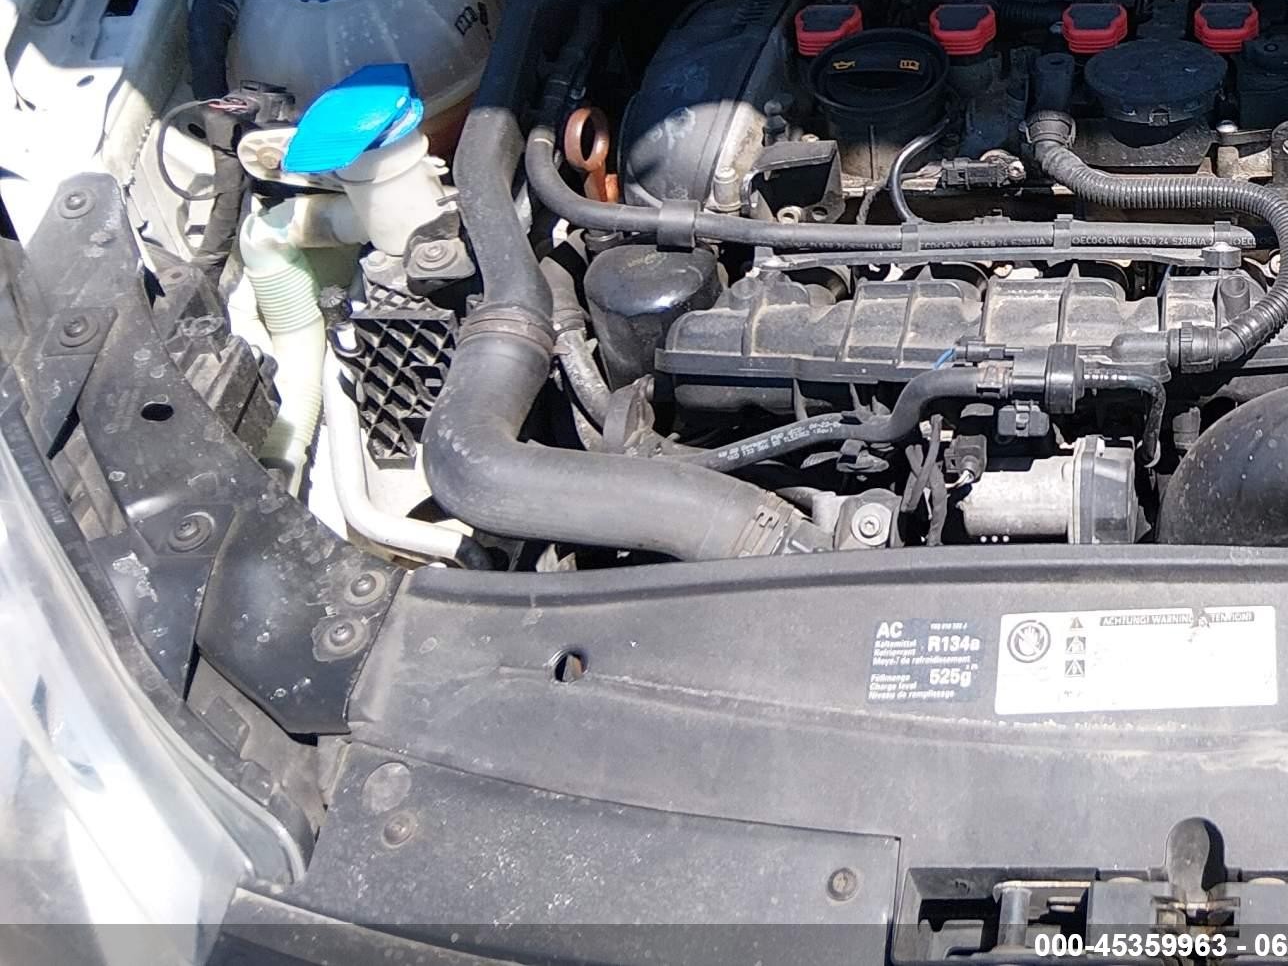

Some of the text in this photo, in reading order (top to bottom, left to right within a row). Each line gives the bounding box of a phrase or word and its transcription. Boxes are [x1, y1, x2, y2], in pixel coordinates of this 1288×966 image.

[876, 621, 904, 639] AC
[927, 635, 981, 652] R134a
[929, 667, 972, 688] 525g
